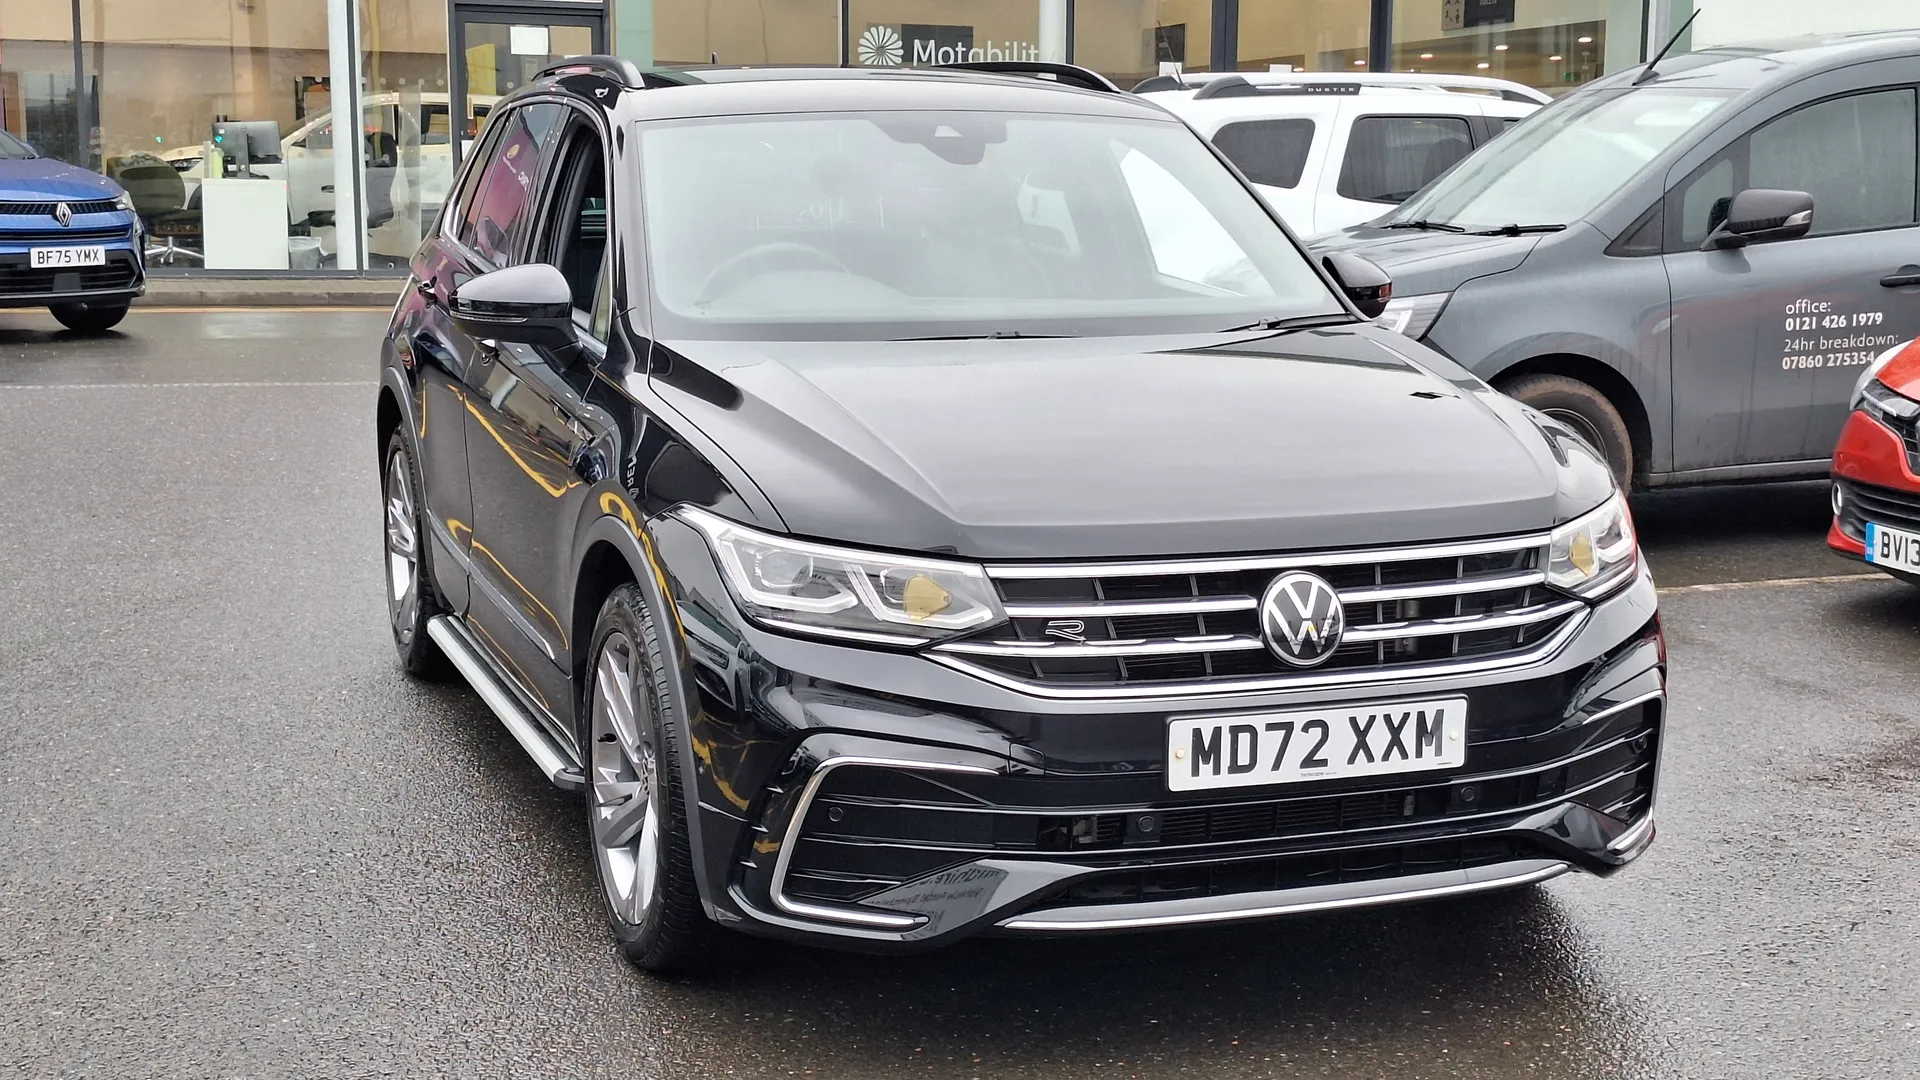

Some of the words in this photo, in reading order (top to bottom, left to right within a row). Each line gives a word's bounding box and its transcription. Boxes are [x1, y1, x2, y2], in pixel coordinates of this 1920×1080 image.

[913, 39, 1039, 67] Motabilit
[37, 250, 71, 264] BF75
[76, 249, 99, 263] YMX
[1785, 299, 1831, 314] office:
[1785, 317, 1816, 331] 0121
[1821, 315, 1846, 329] 426
[1852, 312, 1882, 327] 1979
[1784, 337, 1815, 352] 24hr
[1819, 332, 1898, 350] breakdown:
[1782, 354, 1822, 370] 07860
[1826, 351, 1875, 367] 275354
[1191, 719, 1329, 778] MD72
[1347, 709, 1445, 765] XXM
